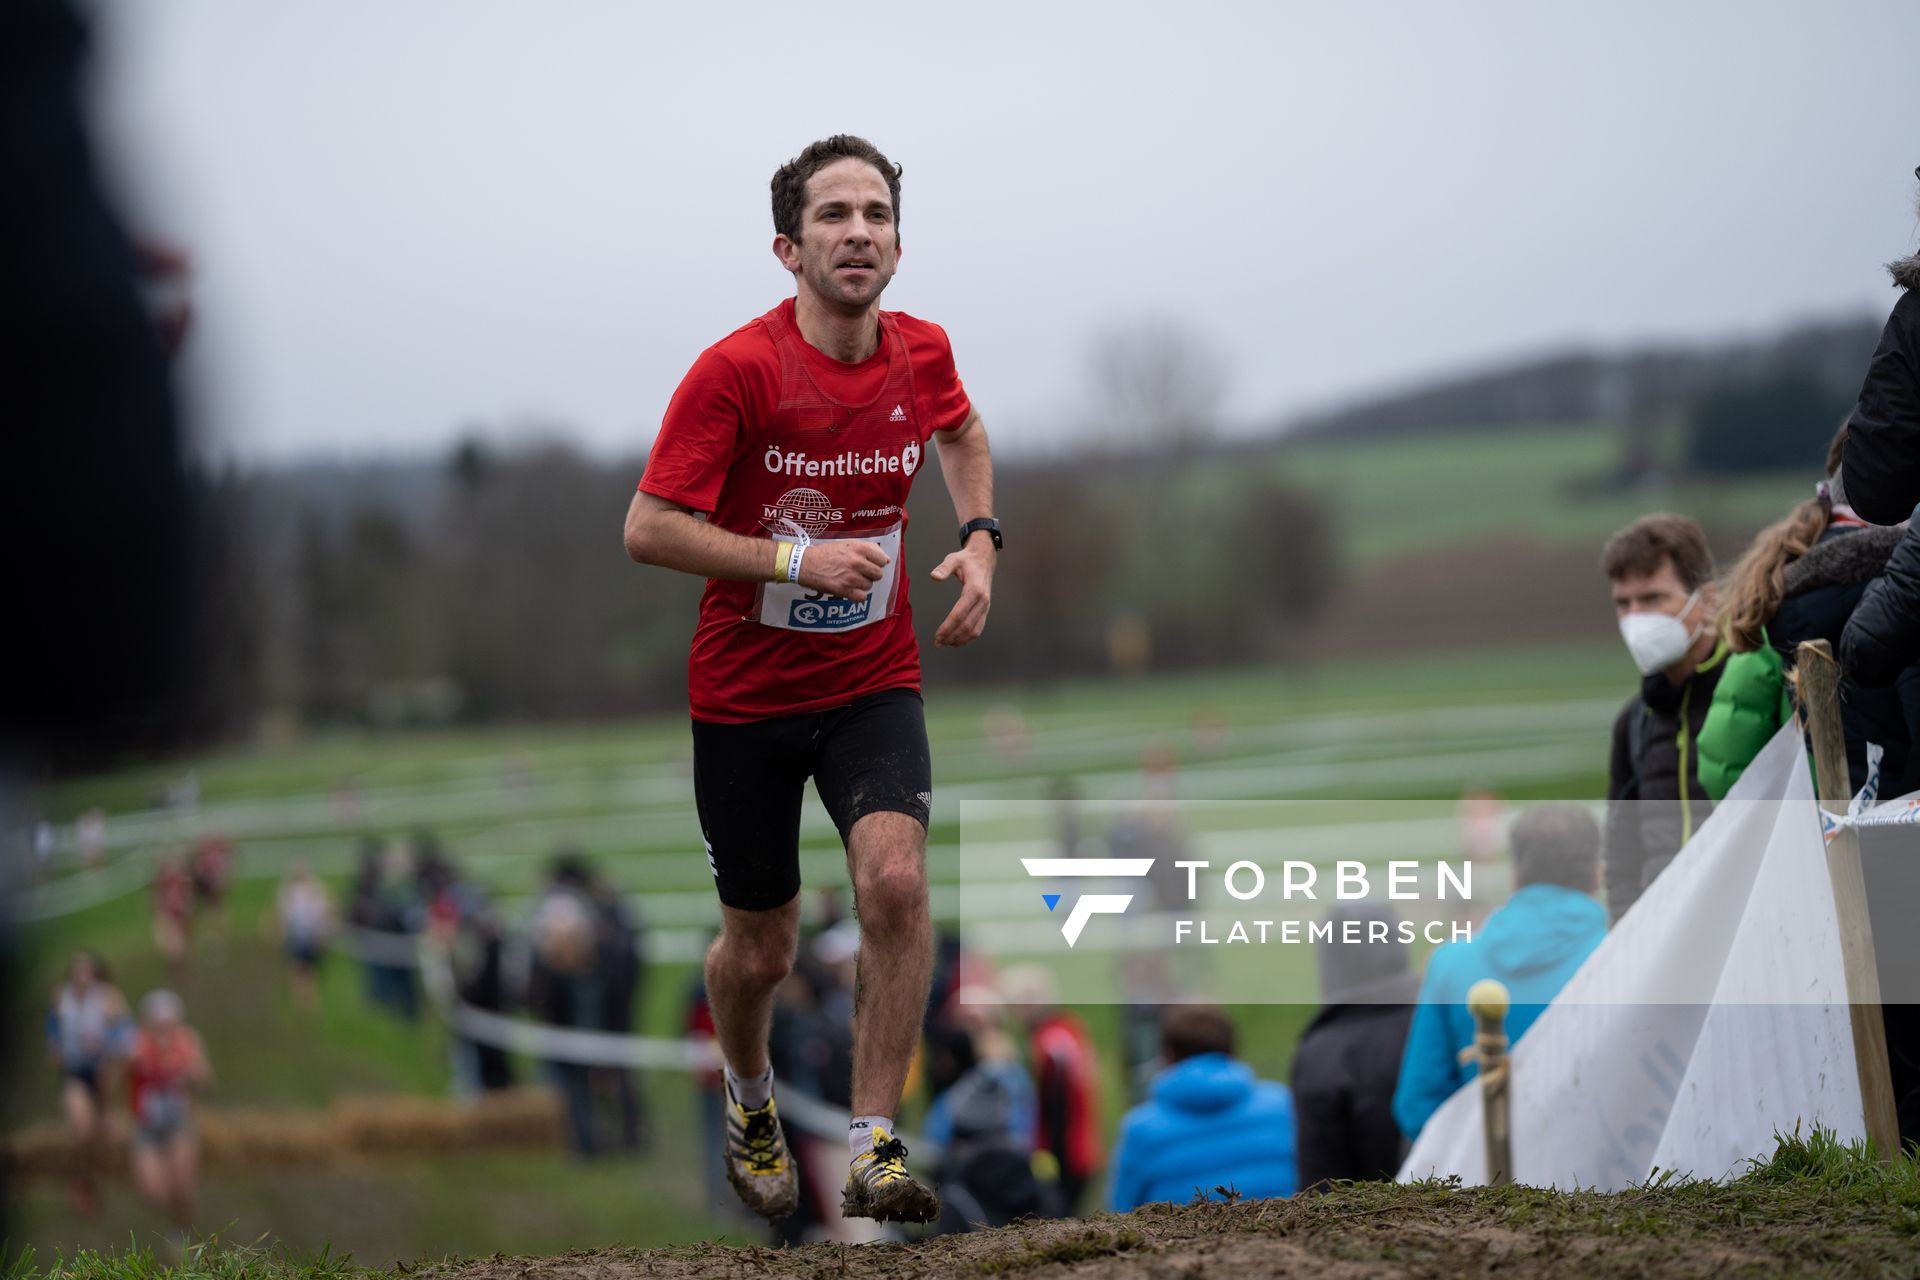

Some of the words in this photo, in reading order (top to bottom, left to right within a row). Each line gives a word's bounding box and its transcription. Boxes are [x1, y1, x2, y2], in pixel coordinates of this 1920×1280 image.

[764, 444, 899, 477] Öffentliche
[764, 507, 843, 521] MIETENS
[827, 601, 868, 618] PLAN
[826, 613, 866, 625] INTERNATIONAL
